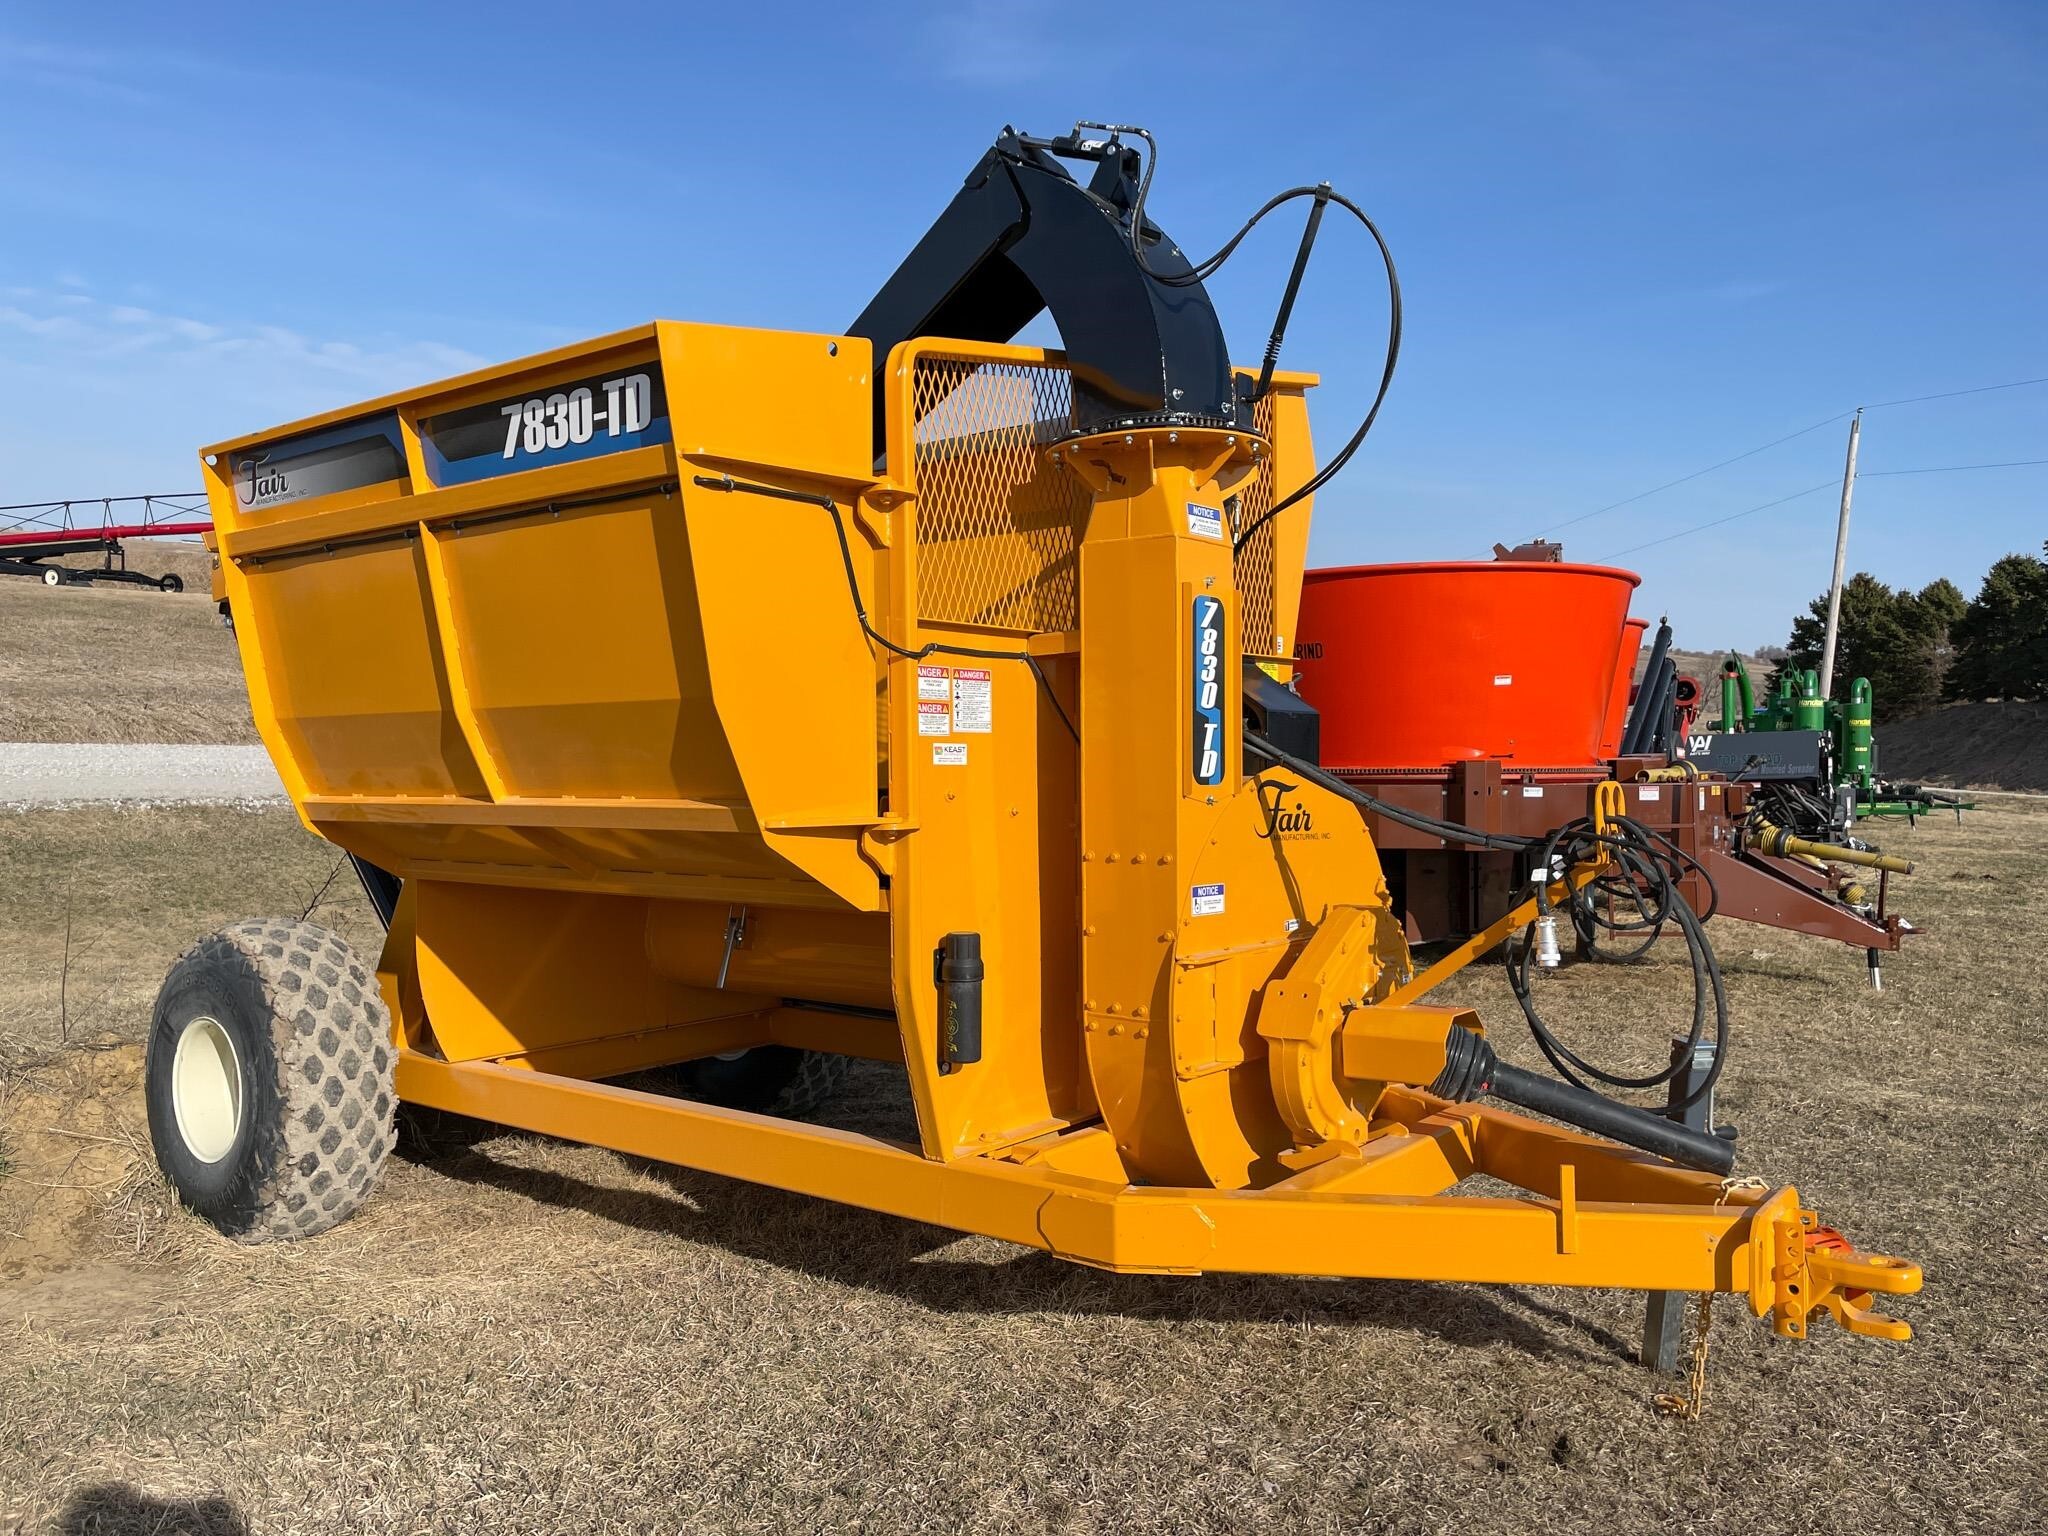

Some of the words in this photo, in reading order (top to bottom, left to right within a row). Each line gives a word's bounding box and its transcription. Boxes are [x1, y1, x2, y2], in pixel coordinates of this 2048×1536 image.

[501, 373, 652, 460] 7830-TD
[238, 448, 290, 506] Fair
[1192, 505, 1215, 519] NOTICE
[1200, 601, 1219, 710] 7830
[1293, 642, 1324, 659] RIND
[918, 666, 942, 678] ANGER
[959, 670, 984, 680] DANGER
[918, 703, 943, 713] ANGER
[944, 745, 966, 753] KEAST
[1200, 723, 1218, 778] TD
[1253, 779, 1314, 839] Fair
[1197, 886, 1219, 897] NOTICE
